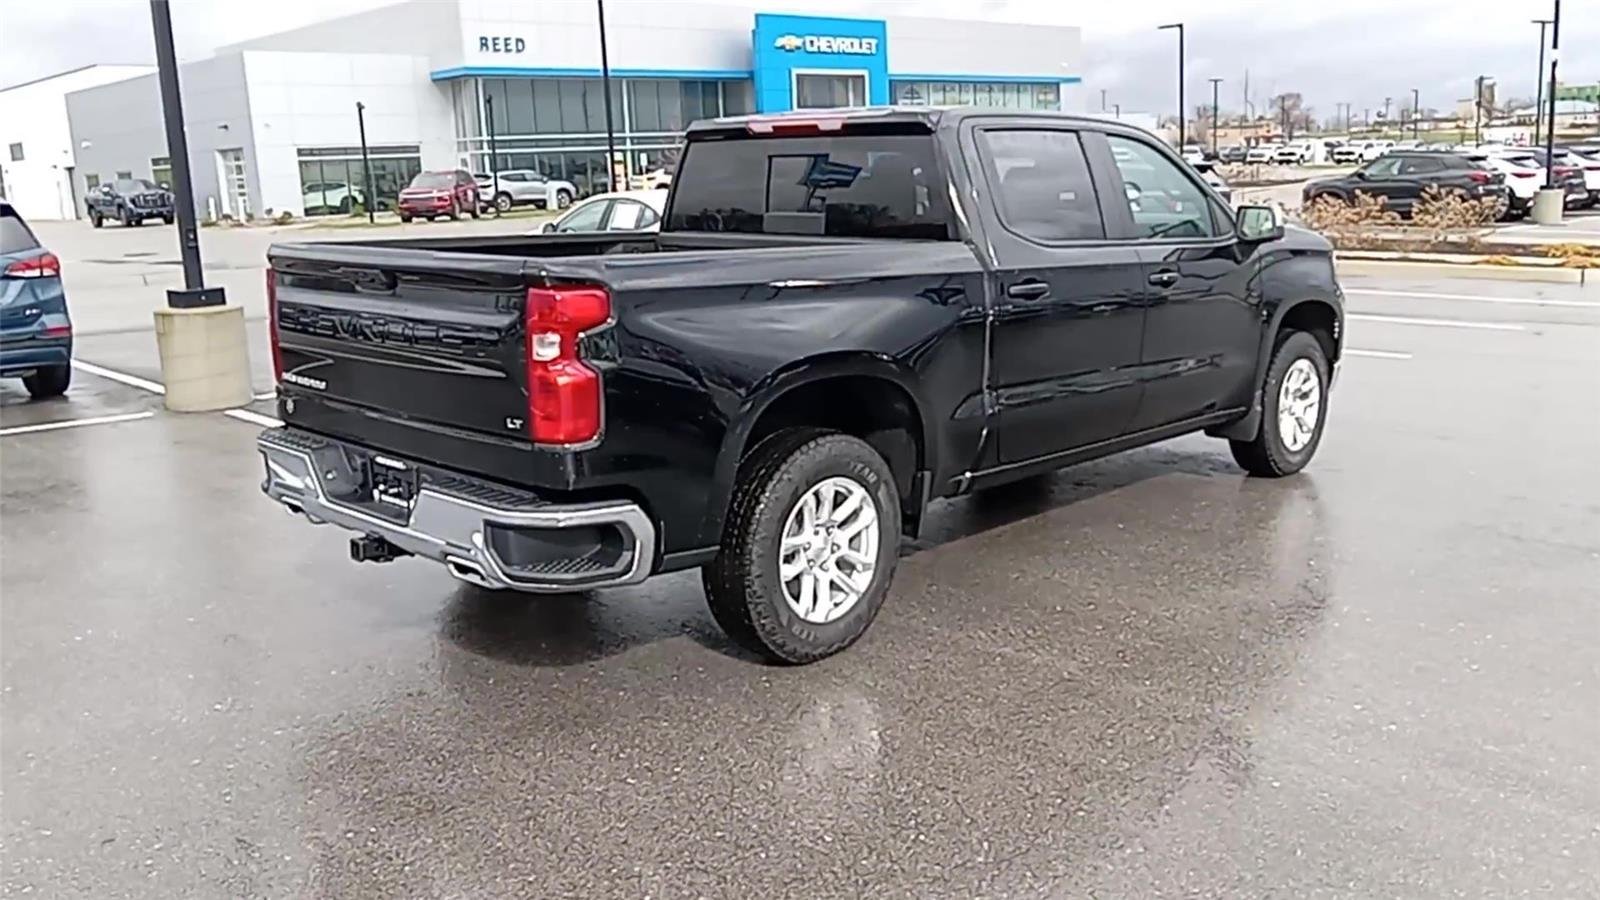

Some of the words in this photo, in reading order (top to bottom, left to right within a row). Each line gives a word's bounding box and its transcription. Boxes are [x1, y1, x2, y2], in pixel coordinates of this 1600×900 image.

[479, 36, 526, 53] REED
[804, 34, 878, 55] CHEVROLET
[506, 417, 524, 429] LT
